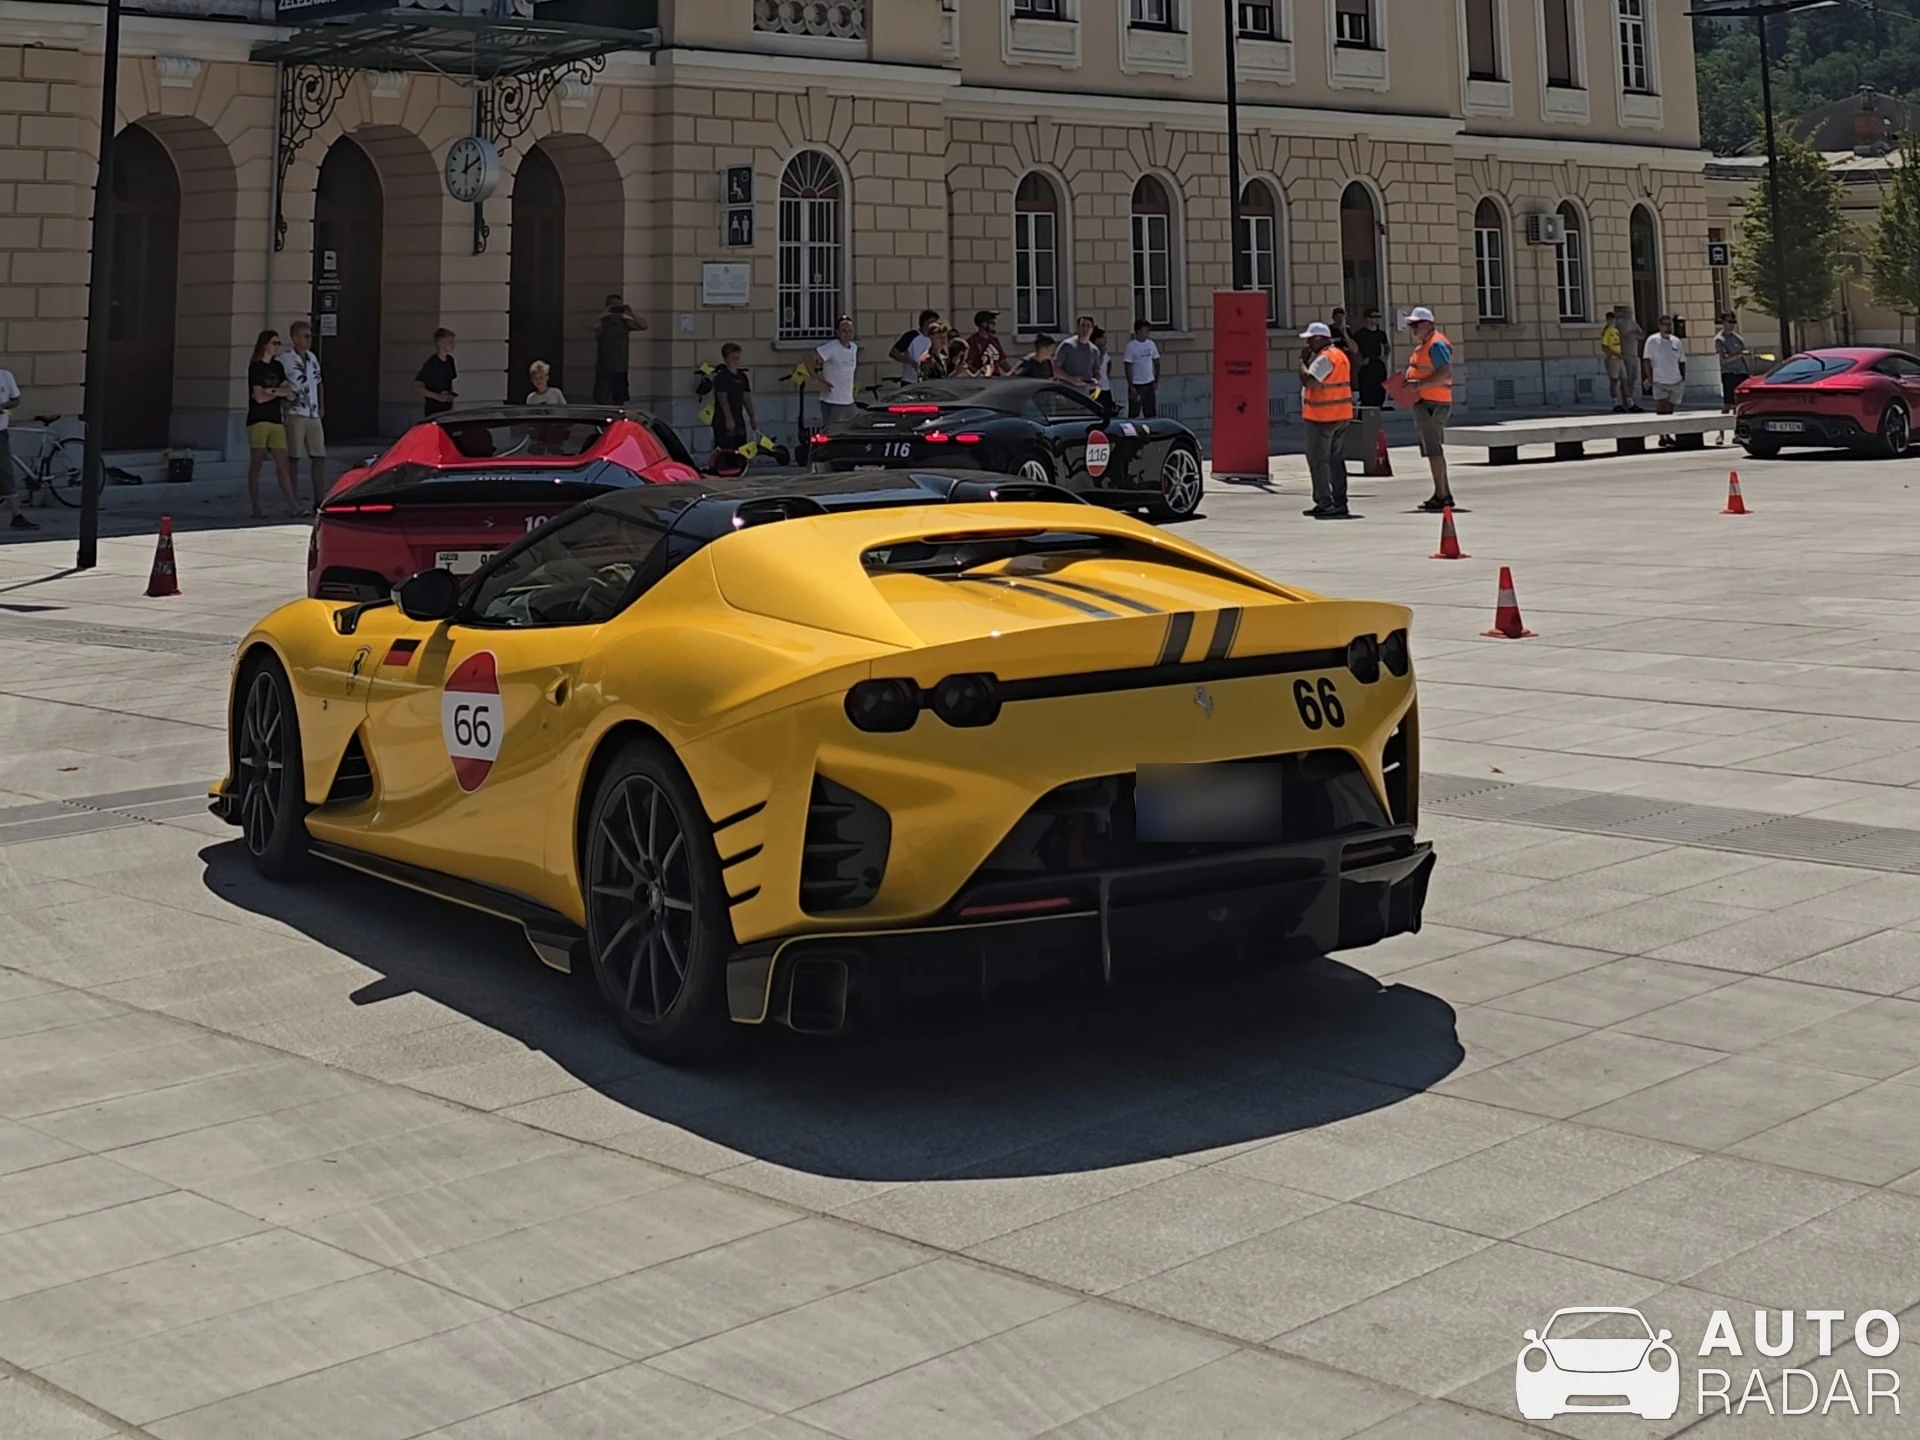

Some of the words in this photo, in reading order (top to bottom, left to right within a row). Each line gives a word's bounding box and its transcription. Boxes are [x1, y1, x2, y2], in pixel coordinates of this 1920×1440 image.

[884, 442, 911, 457] 116
[1088, 448, 1108, 462] 116
[524, 515, 560, 533] 10
[1293, 677, 1345, 730] 66
[454, 704, 491, 748] 66
